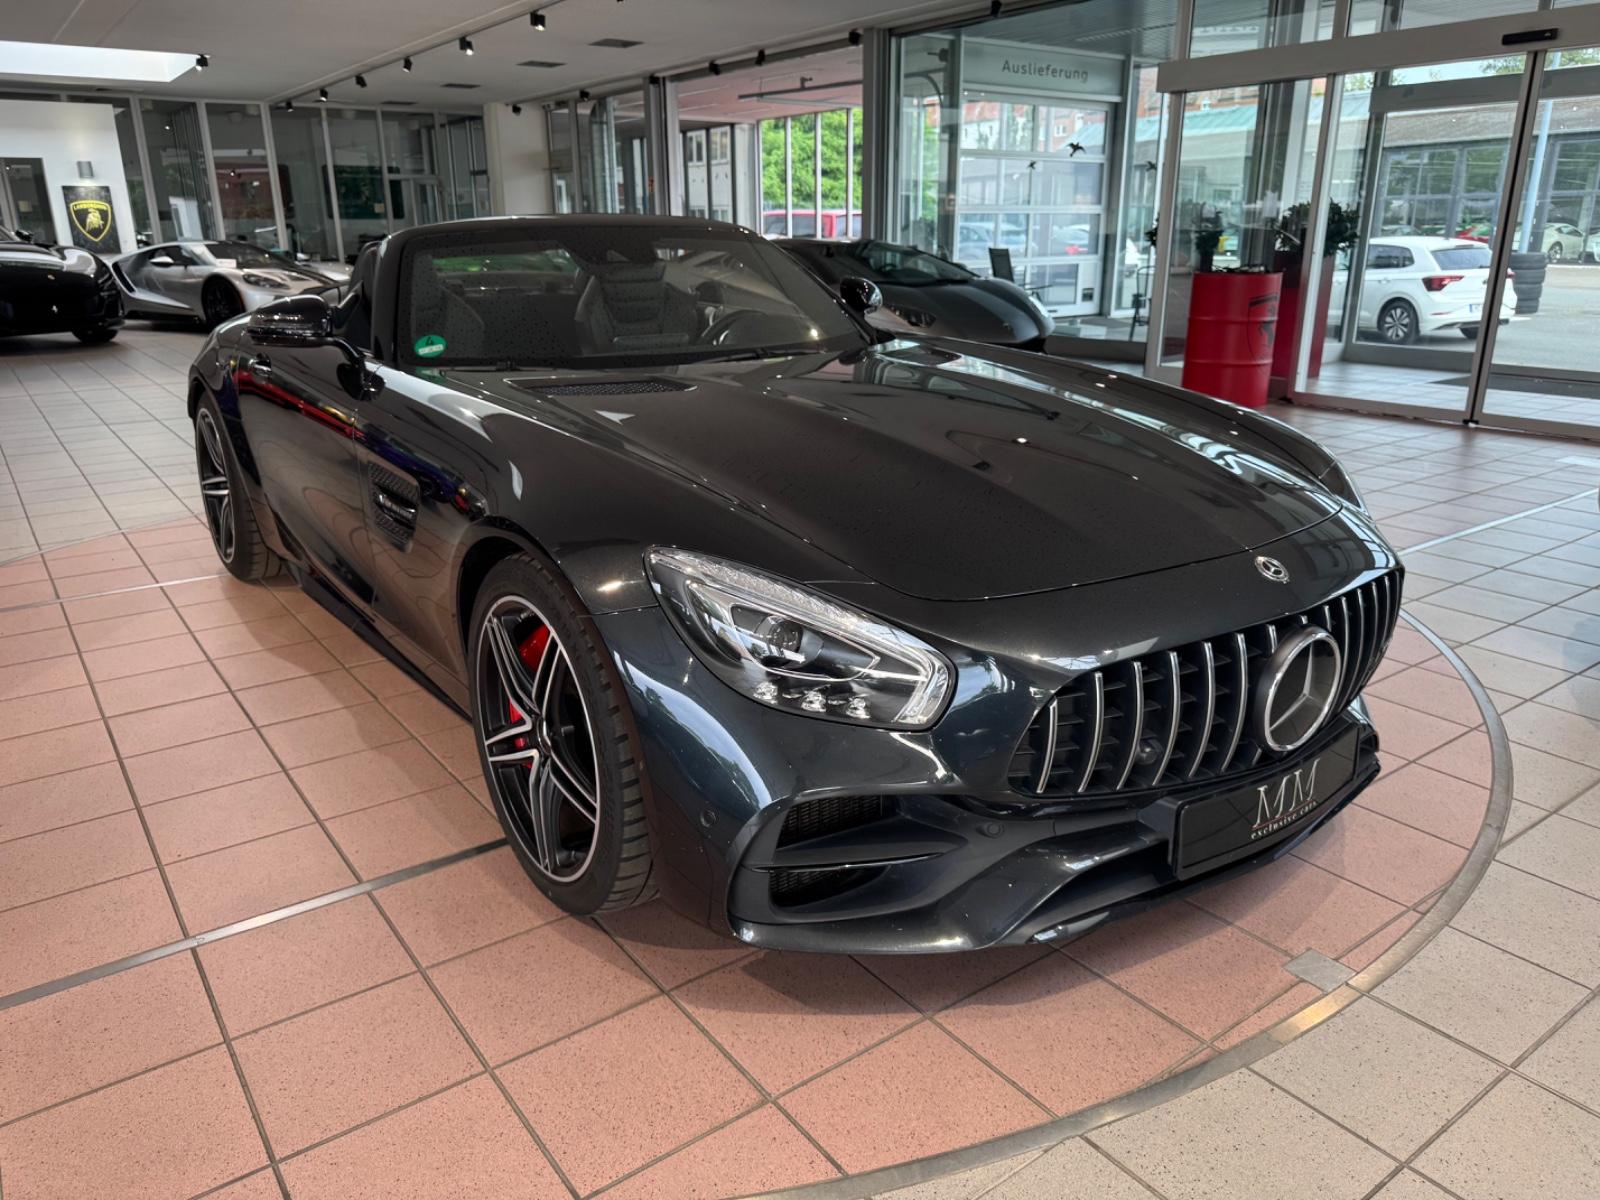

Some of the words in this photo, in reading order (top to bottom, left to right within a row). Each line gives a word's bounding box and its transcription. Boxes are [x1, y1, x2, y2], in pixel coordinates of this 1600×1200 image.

[1002, 59, 1089, 84] Auslieferung
[1252, 758, 1321, 828] MM
[1251, 812, 1298, 840] exclusive
